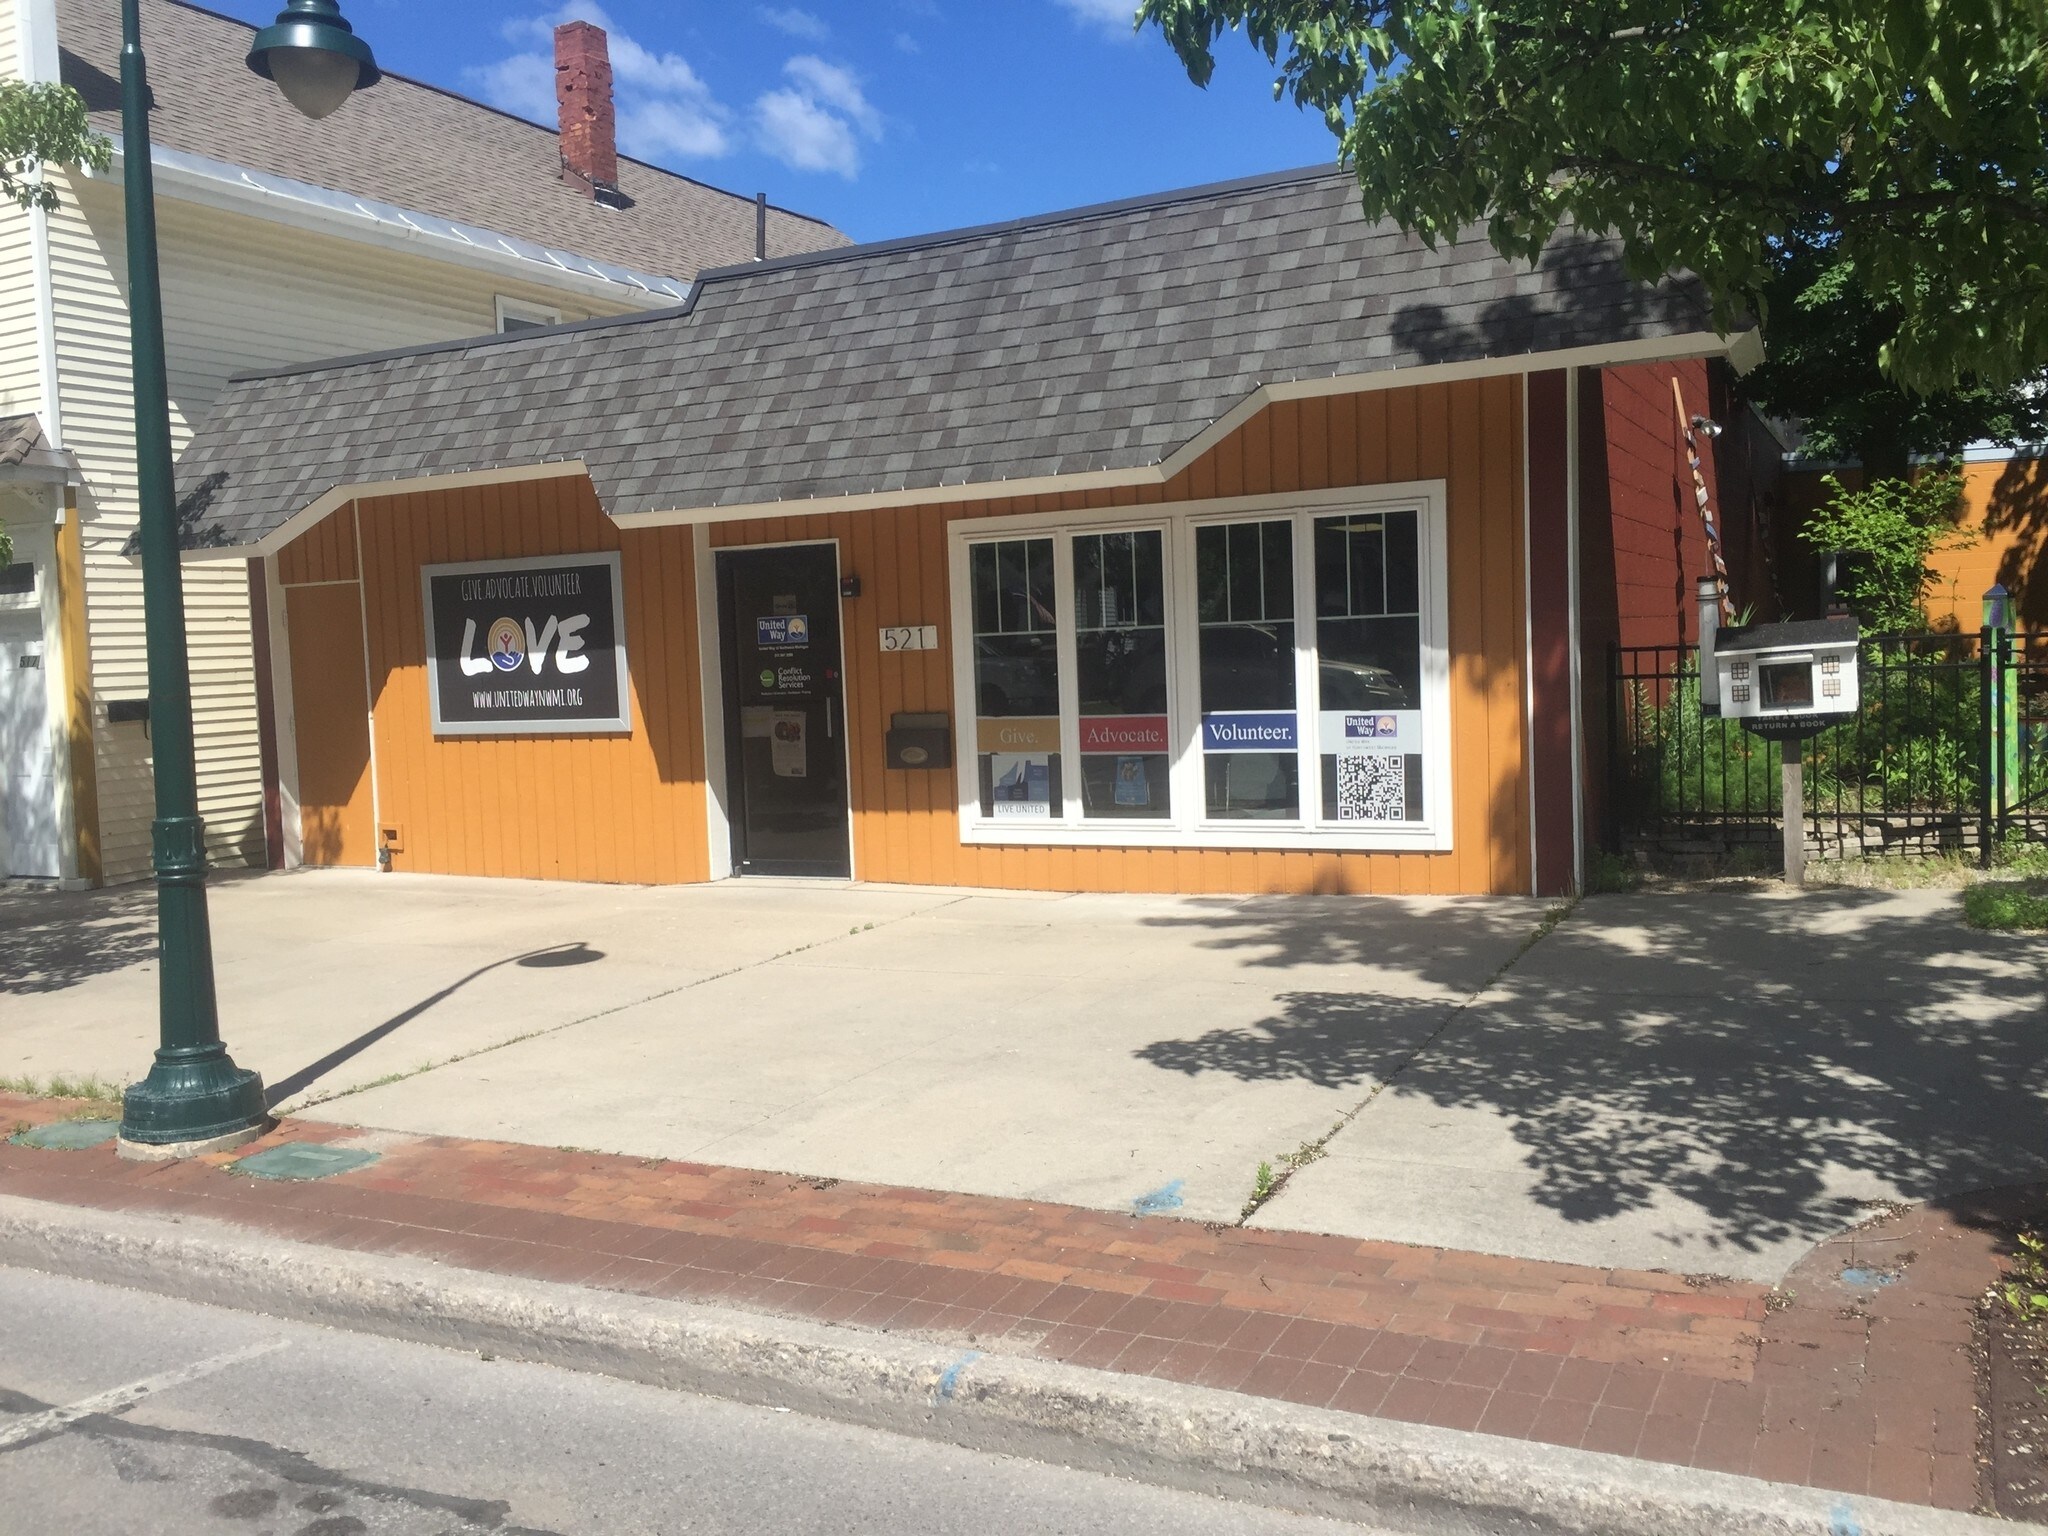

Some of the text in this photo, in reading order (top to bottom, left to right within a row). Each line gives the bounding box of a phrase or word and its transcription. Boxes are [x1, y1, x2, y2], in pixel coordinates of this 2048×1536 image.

[759, 619, 786, 630] United
[770, 630, 786, 642] Way
[884, 627, 925, 651] 521
[778, 667, 803, 675] Conflict
[778, 674, 811, 682] Resolution
[778, 681, 804, 689] Services
[472, 688, 583, 708] WWW.UNITEDWAYNWMI.ORG
[1346, 717, 1375, 726] United
[1751, 722, 1788, 730] RETURN
[1800, 720, 1826, 728] BOOK
[1000, 727, 1038, 743] Give.
[1087, 727, 1164, 743] Advocate.
[1209, 723, 1292, 741] Volunteer.
[1357, 726, 1375, 736] Way
[998, 804, 1045, 814] LIVE UNITED
